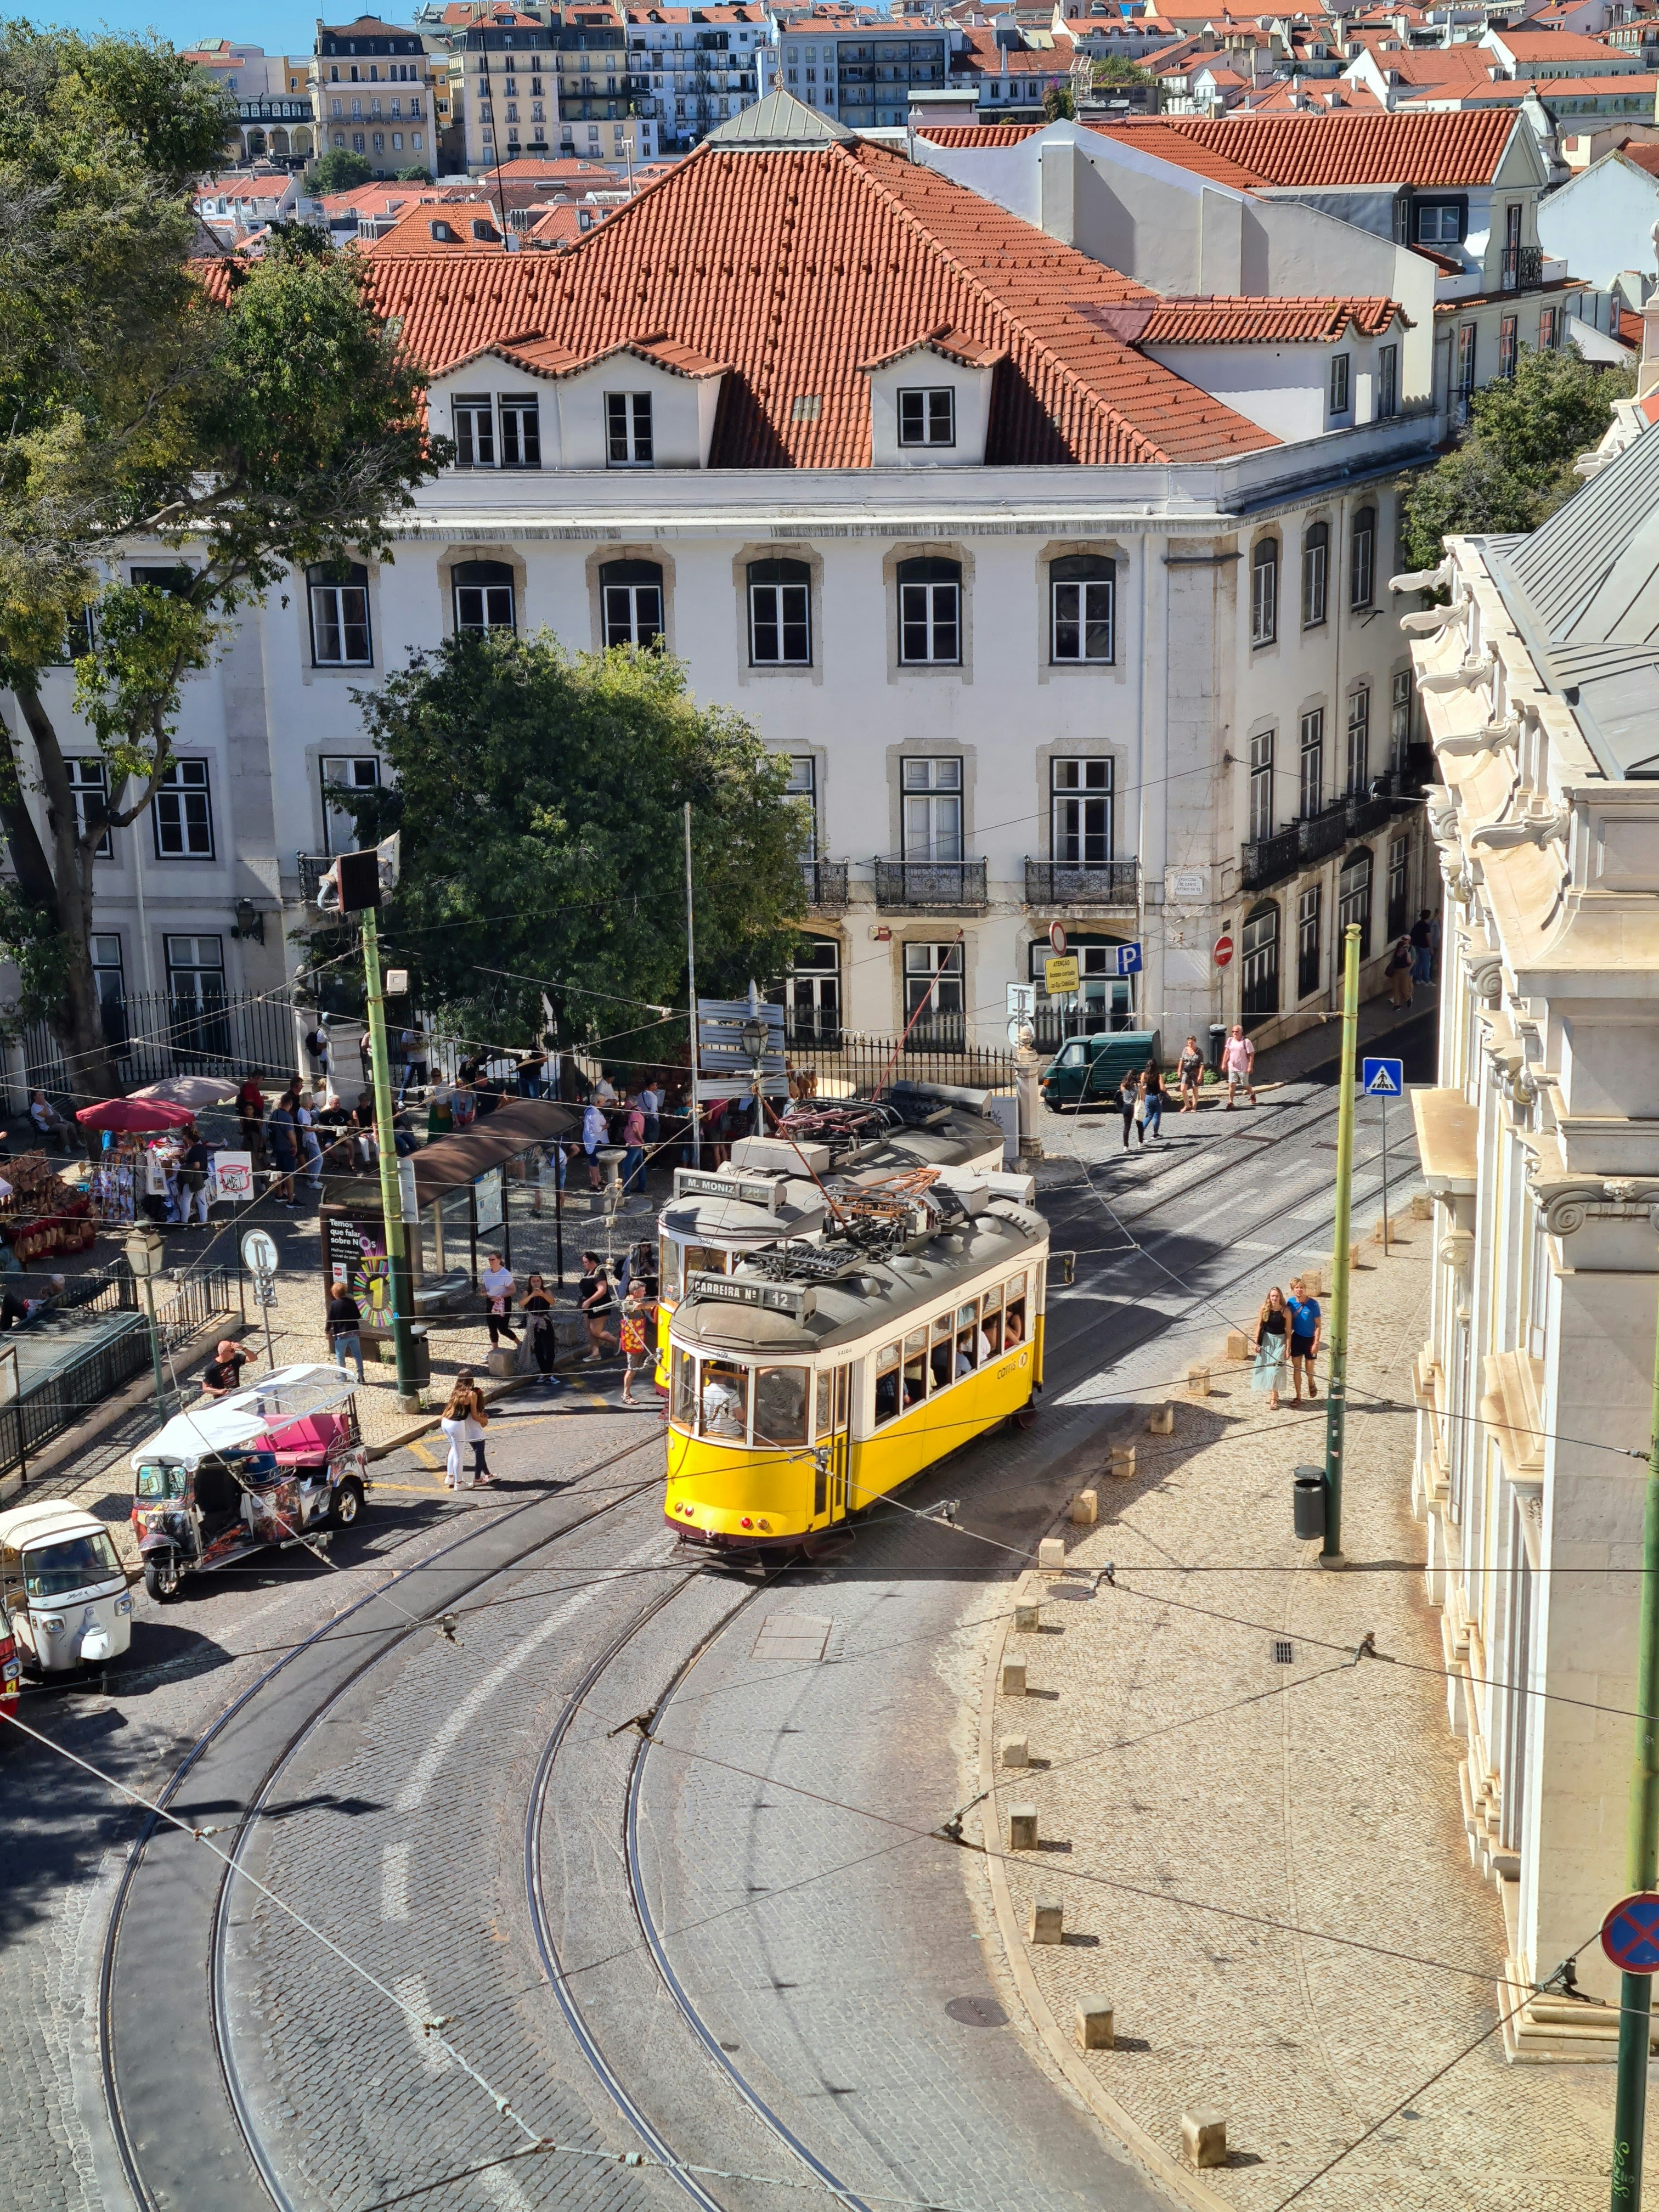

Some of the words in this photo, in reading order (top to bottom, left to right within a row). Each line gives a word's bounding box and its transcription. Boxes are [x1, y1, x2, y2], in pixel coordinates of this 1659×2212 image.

[1053, 959, 1070, 967] ATENÇÃO
[1122, 947, 1137, 972] P
[688, 1178, 699, 1187] M.
[702, 1180, 735, 1194] MONIZ
[744, 1186, 760, 1198] 28
[329, 1218, 353, 1228] Temos
[345, 1228, 361, 1238] falar
[330, 1235, 351, 1245] sobre
[353, 1236, 376, 1250] NOS
[695, 1281, 740, 1297] CARREIRA
[772, 1291, 788, 1307] 12
[838, 1347, 852, 1356] SAÍDA
